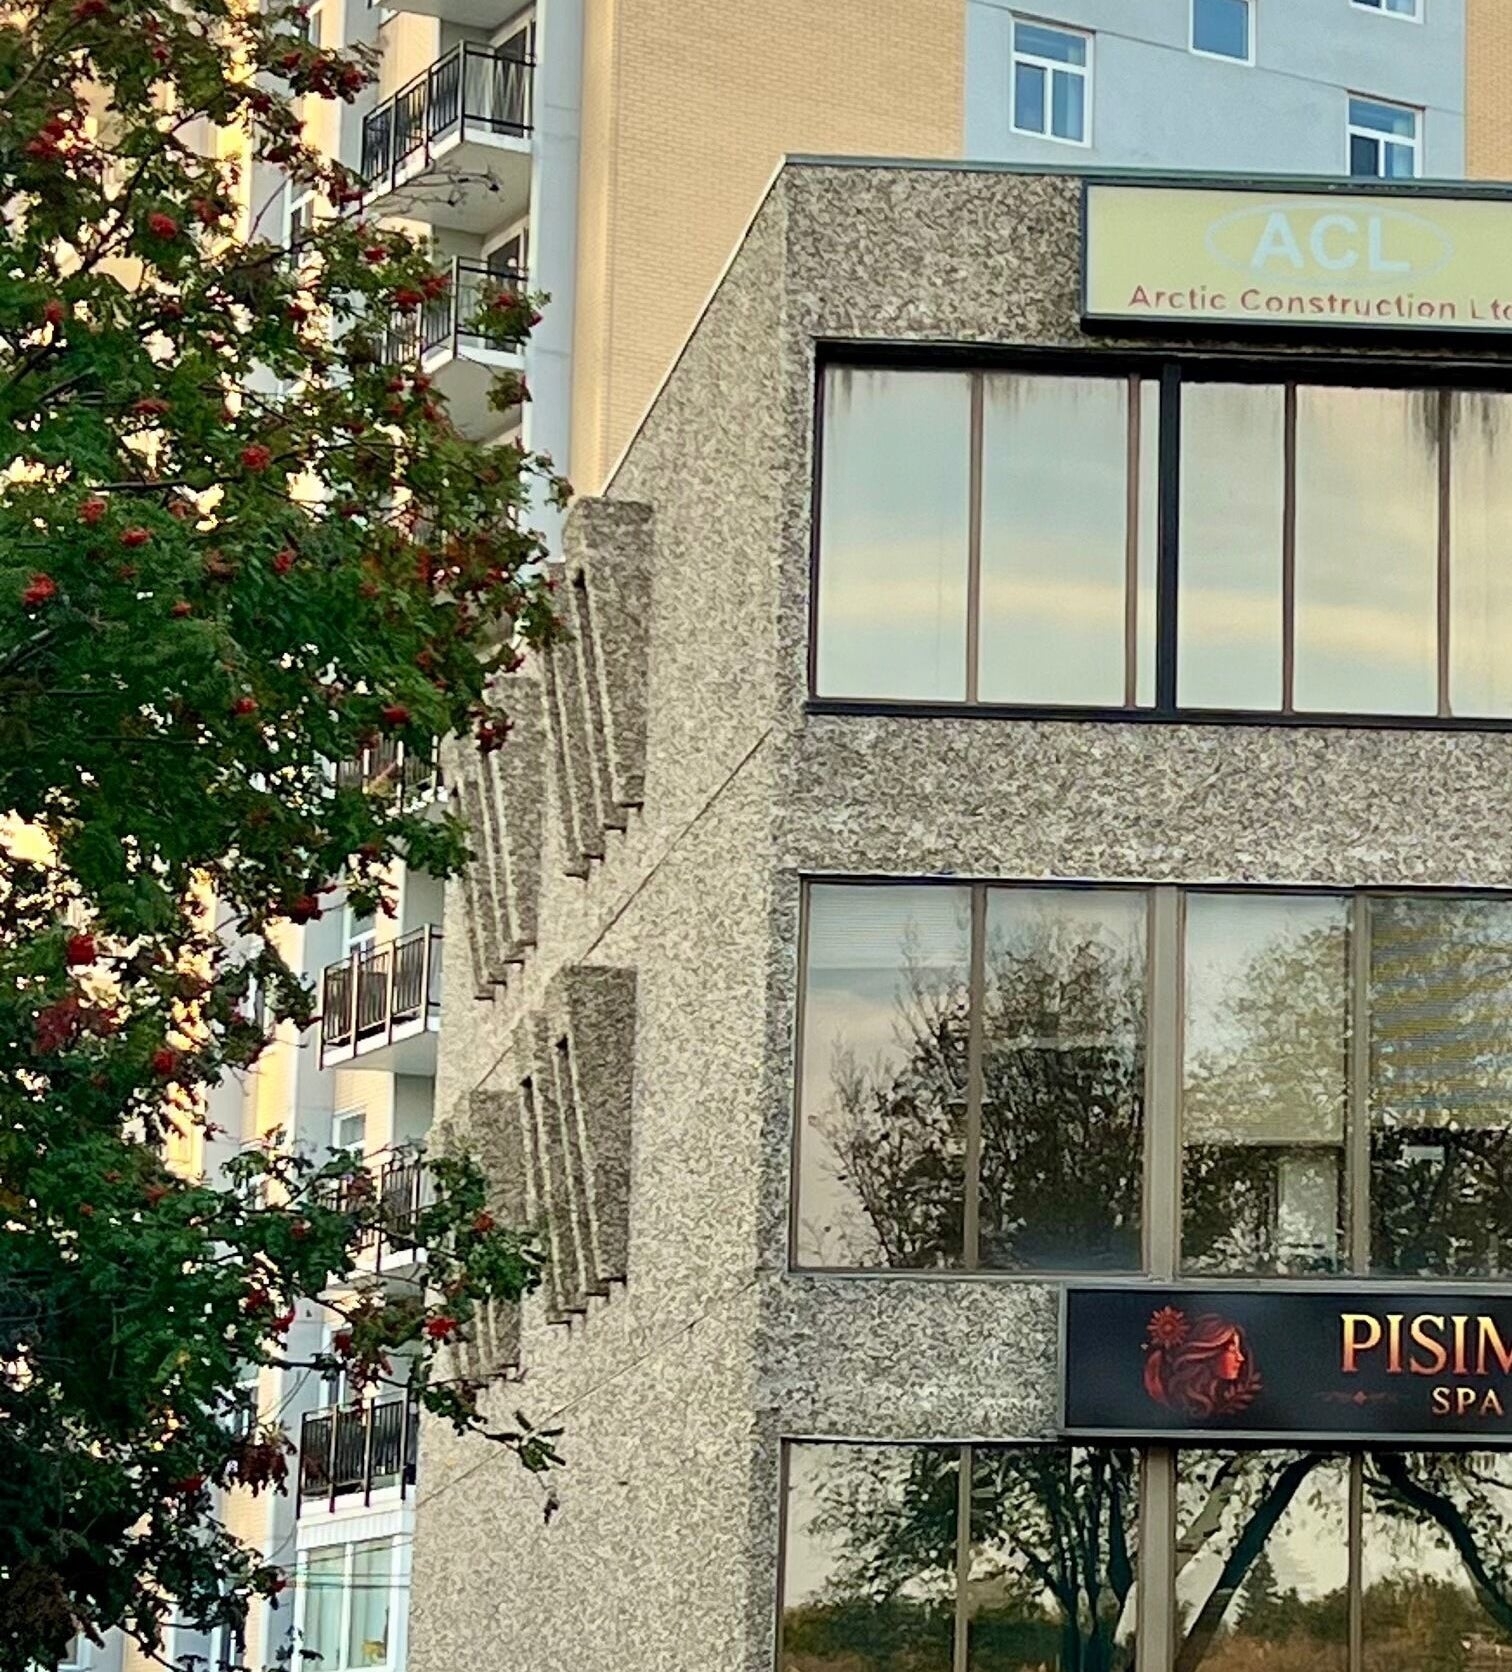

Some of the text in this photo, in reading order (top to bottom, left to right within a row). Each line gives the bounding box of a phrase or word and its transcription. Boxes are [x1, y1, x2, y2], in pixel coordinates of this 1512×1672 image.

[1250, 212, 1411, 273] ACL
[1127, 285, 1226, 311] Arctic
[1241, 288, 1456, 320] Construction
[1431, 1386, 1504, 1417] SPA
